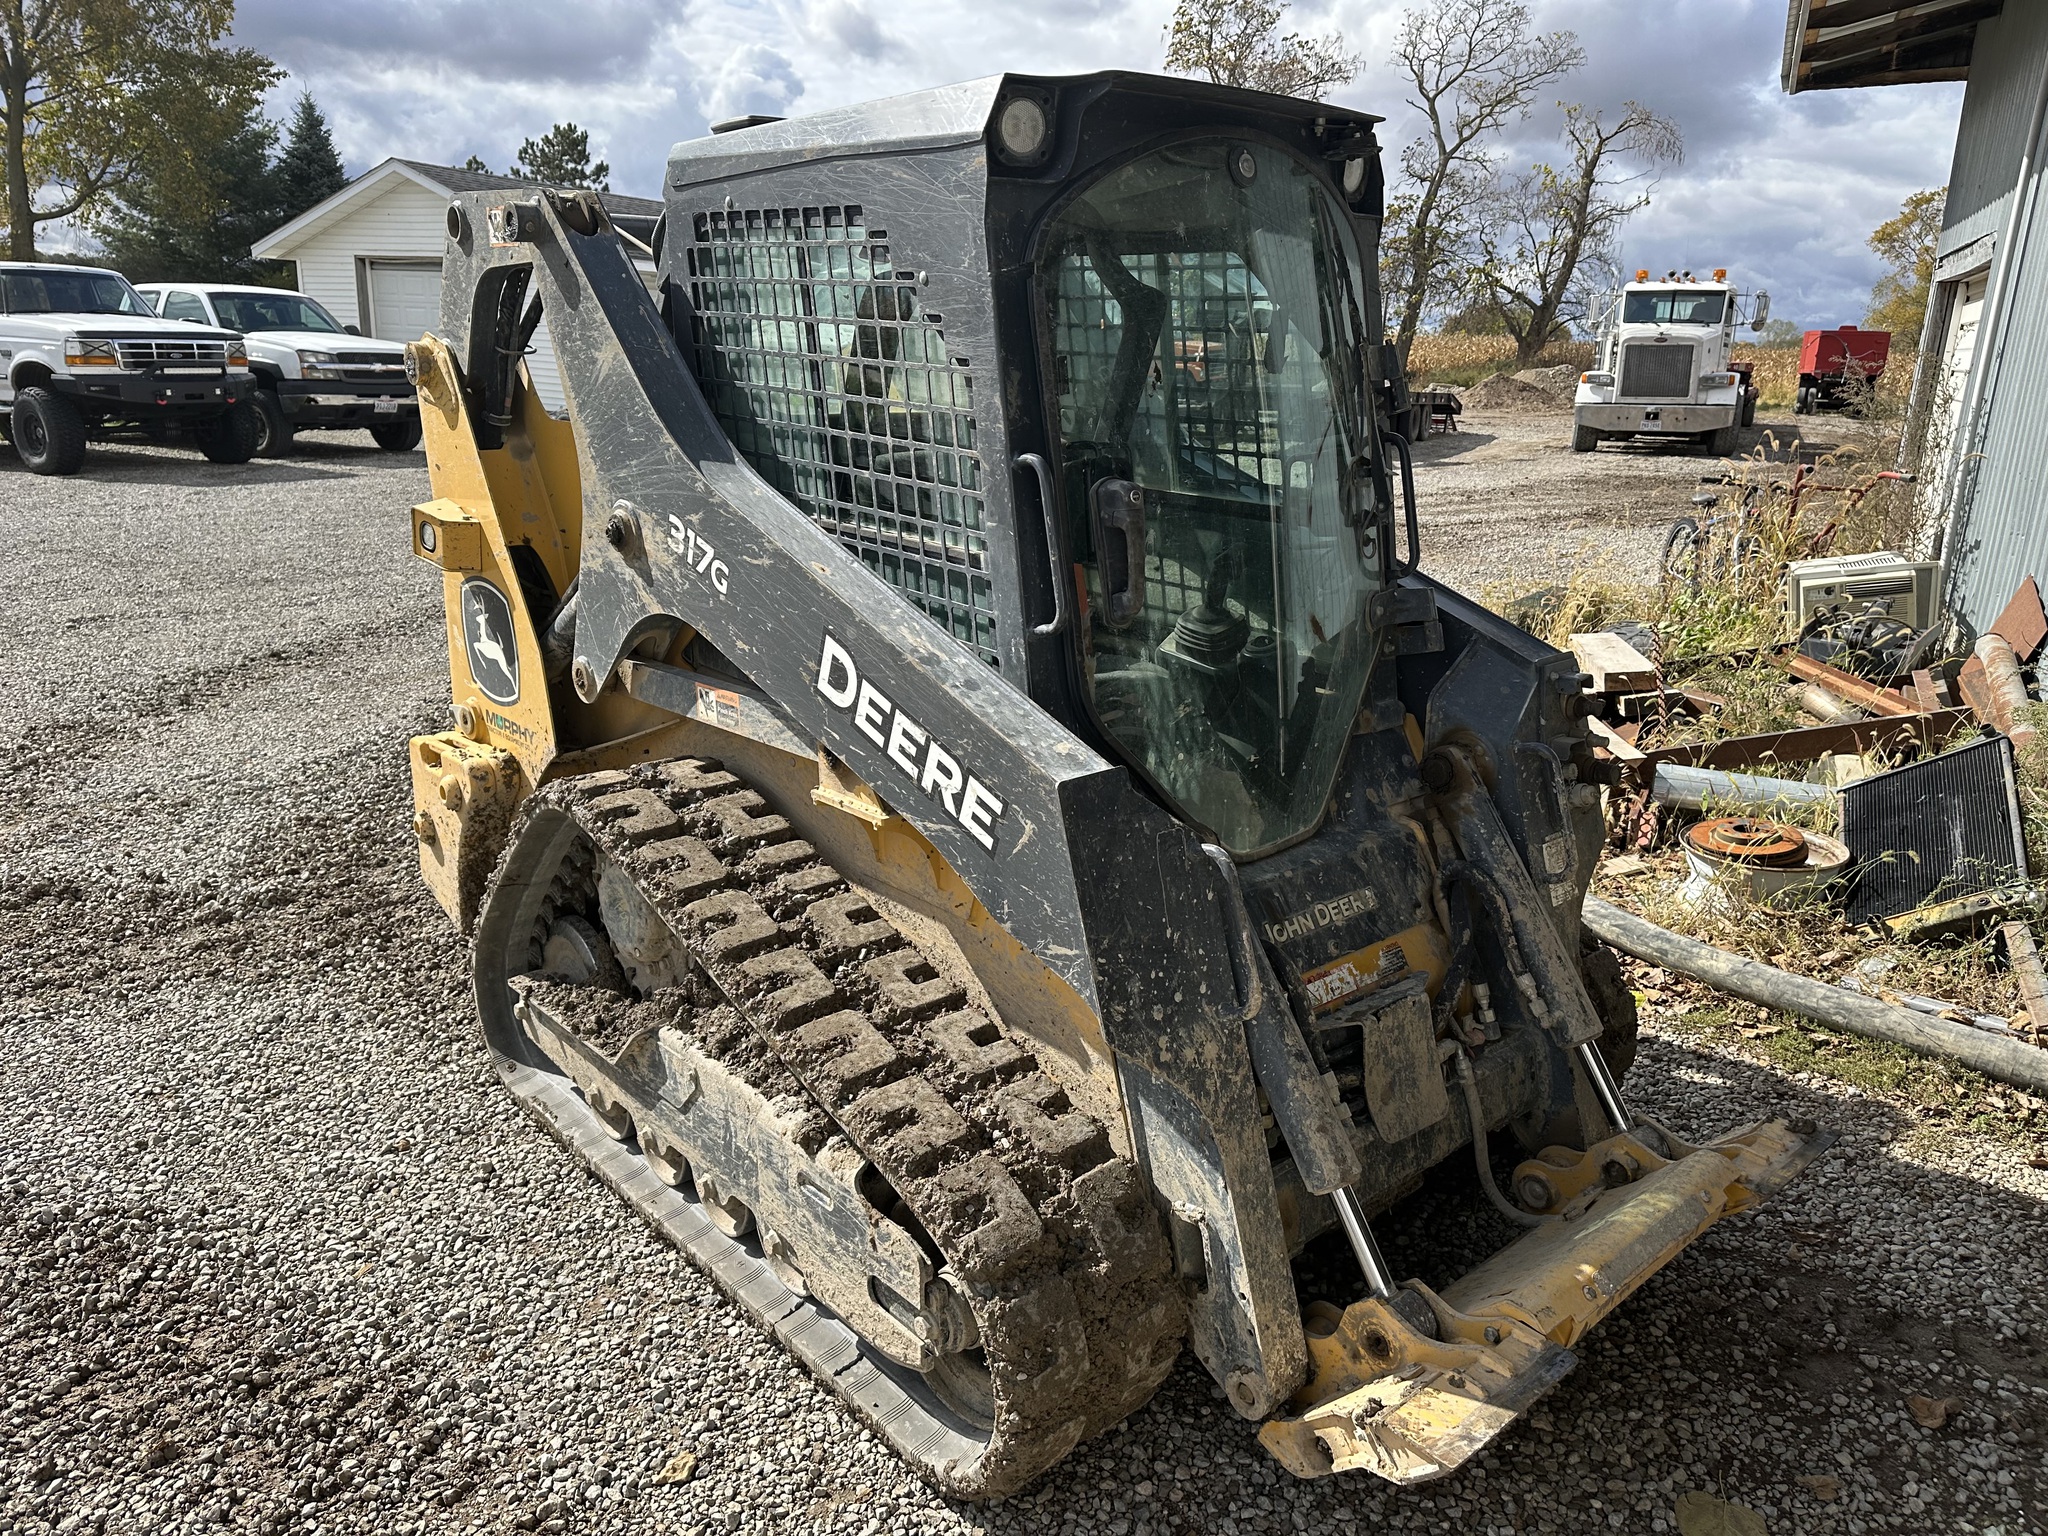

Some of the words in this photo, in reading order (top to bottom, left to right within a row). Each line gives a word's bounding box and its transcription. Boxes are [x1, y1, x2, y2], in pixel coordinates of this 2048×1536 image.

[667, 513, 730, 595] 317G
[485, 709, 536, 745] MURPHY
[816, 633, 1005, 851] DEERE
[1264, 913, 1315, 943] JOHN
[1314, 887, 1376, 927] DEER
